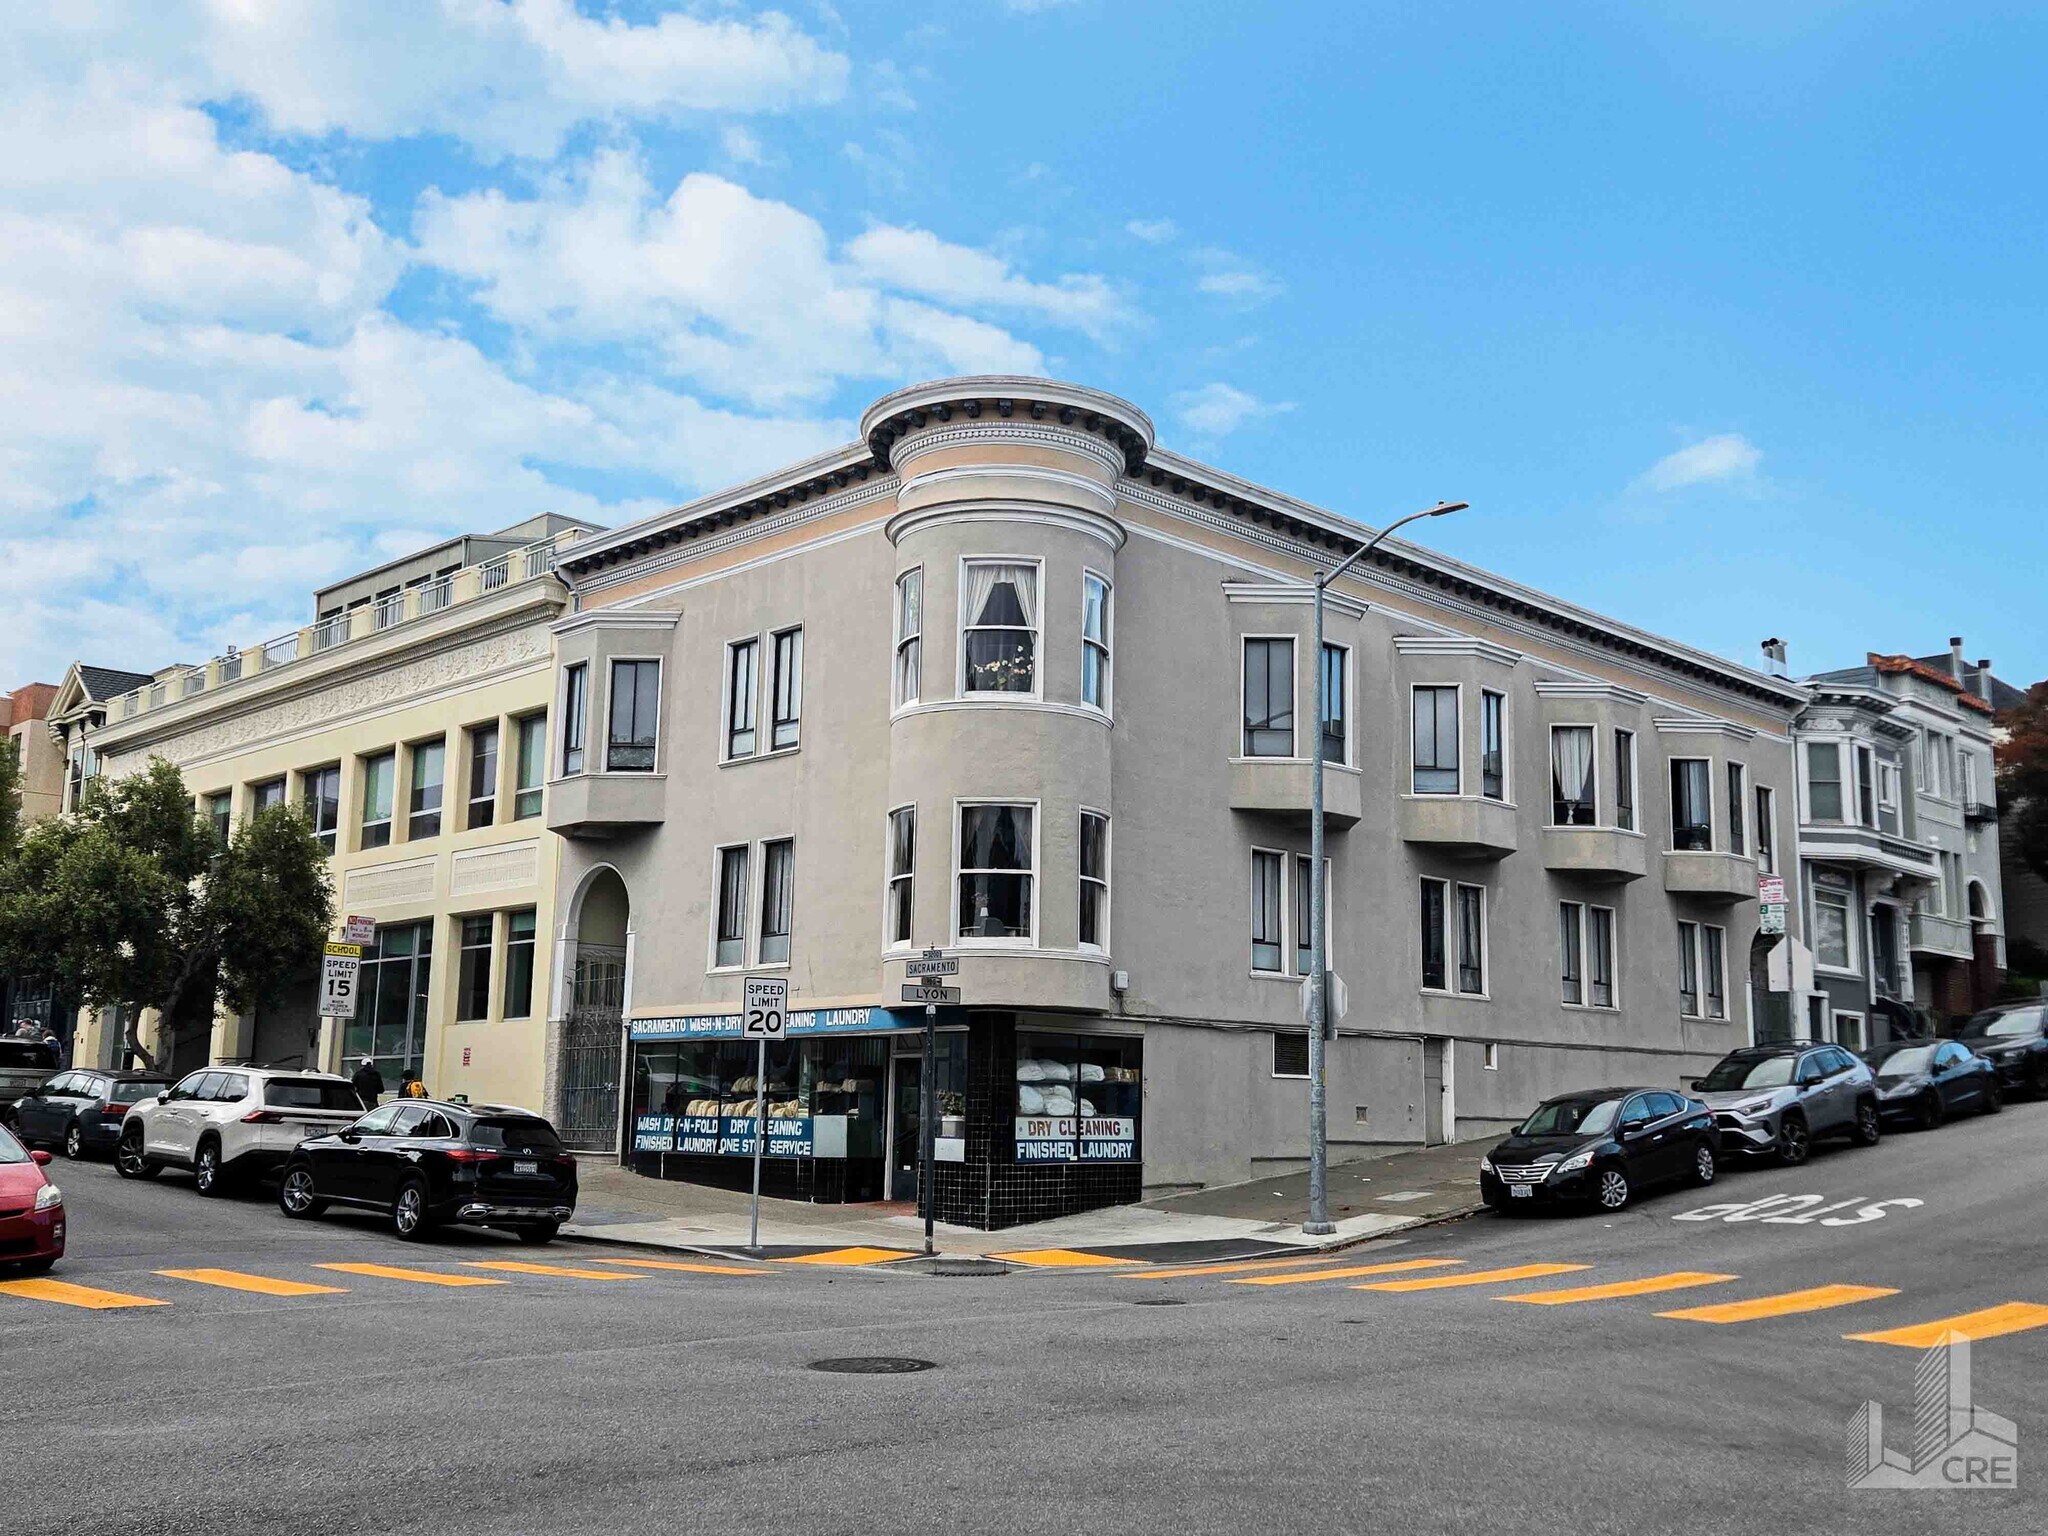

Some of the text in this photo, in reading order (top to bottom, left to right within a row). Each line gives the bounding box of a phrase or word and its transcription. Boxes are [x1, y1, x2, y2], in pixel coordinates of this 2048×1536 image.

[327, 945, 359, 955] SCHOOL
[326, 960, 357, 969] SPEED
[909, 961, 955, 974] SACRAMENTO
[328, 969, 353, 978] LIMIT
[328, 979, 351, 997] 15
[748, 984, 784, 995] SPEED
[916, 988, 948, 1000] LYON
[751, 997, 780, 1007] LIMIT
[632, 1018, 686, 1034] SACRAMENTO
[826, 1008, 871, 1026] LAUNDRY
[748, 1010, 781, 1032] 20
[637, 1116, 661, 1131] WASH
[730, 1119, 750, 1134] DRY
[1028, 1120, 1121, 1136] DRY CLEANING
[635, 1134, 673, 1150] FINISHED
[677, 1137, 717, 1153] LAUNDRY
[720, 1137, 740, 1152] ONE
[769, 1140, 811, 1155] SERVICE
[1017, 1142, 1132, 1159] FINISHED LAUNDRY
[1672, 1193, 1924, 1227] STOP
